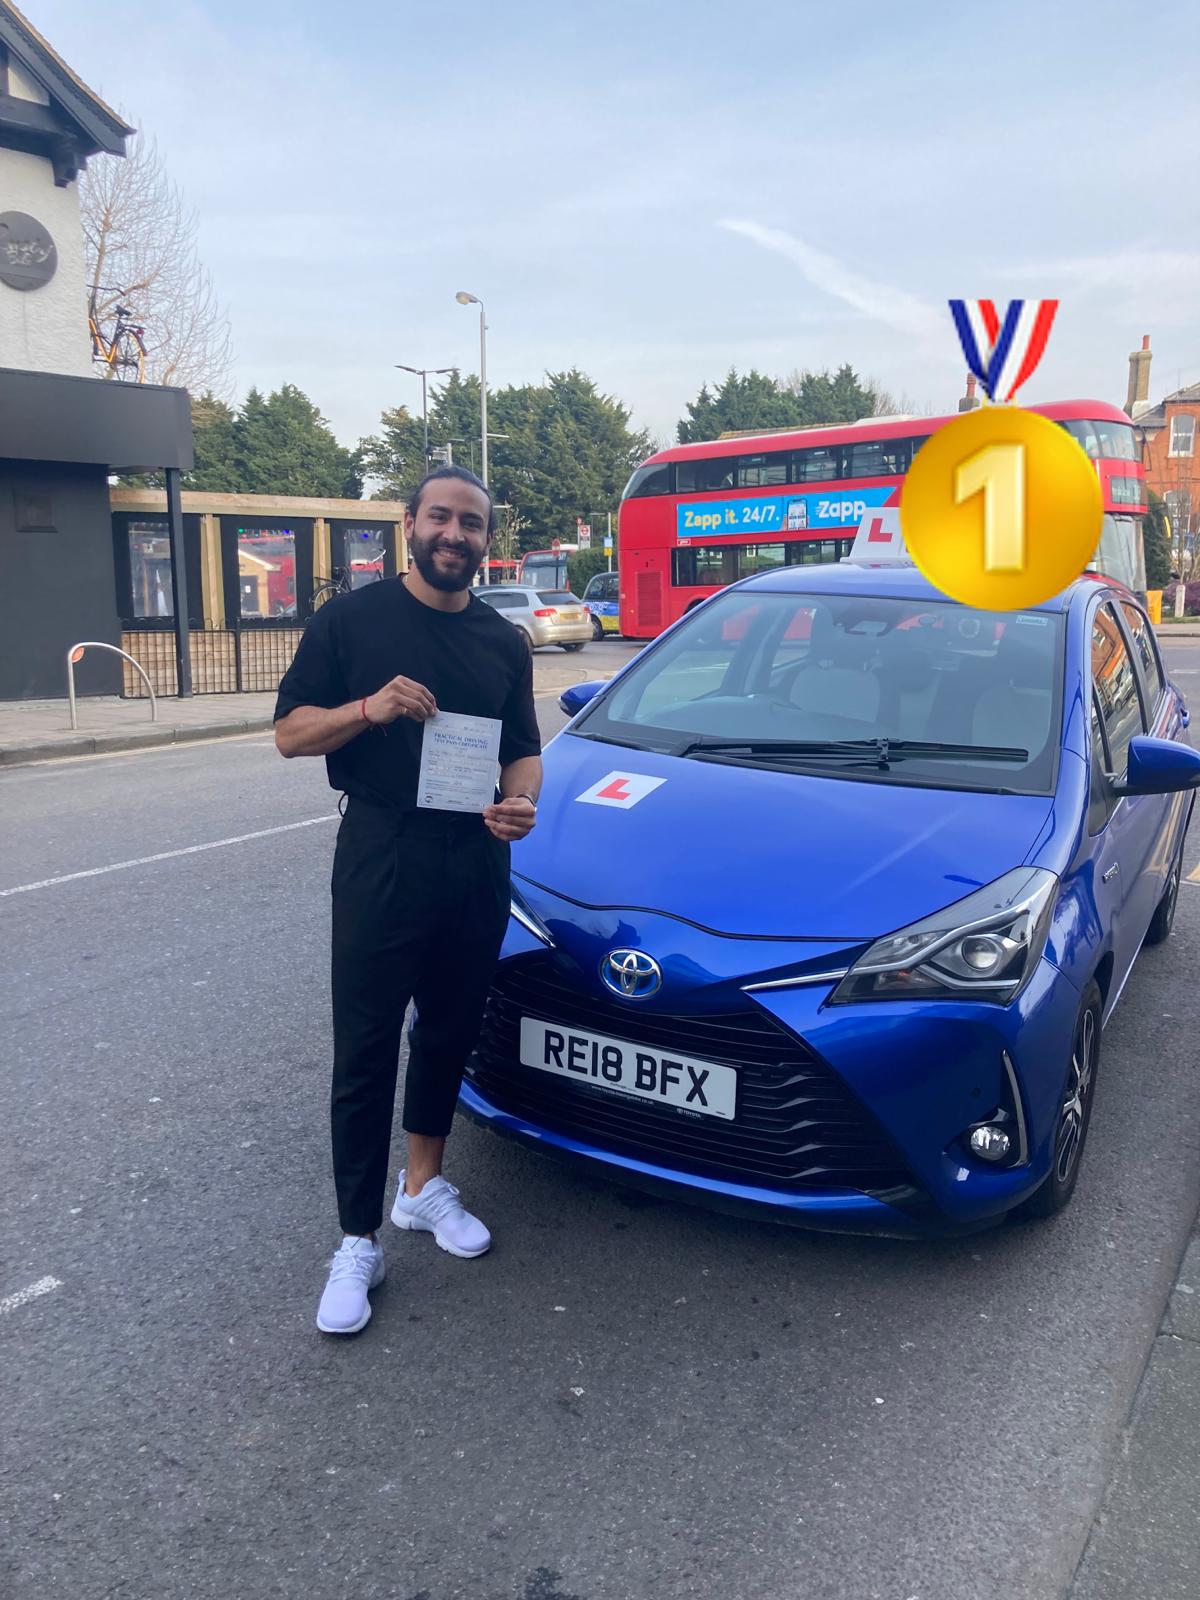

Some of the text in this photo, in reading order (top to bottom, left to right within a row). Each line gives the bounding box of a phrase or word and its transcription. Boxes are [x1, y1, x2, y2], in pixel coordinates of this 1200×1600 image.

[684, 504, 780, 530] Zapp it. 24/7.
[817, 500, 867, 522] Zapp
[868, 518, 893, 542] L
[596, 778, 631, 801] L
[544, 1029, 710, 1107] RE18 BFX
